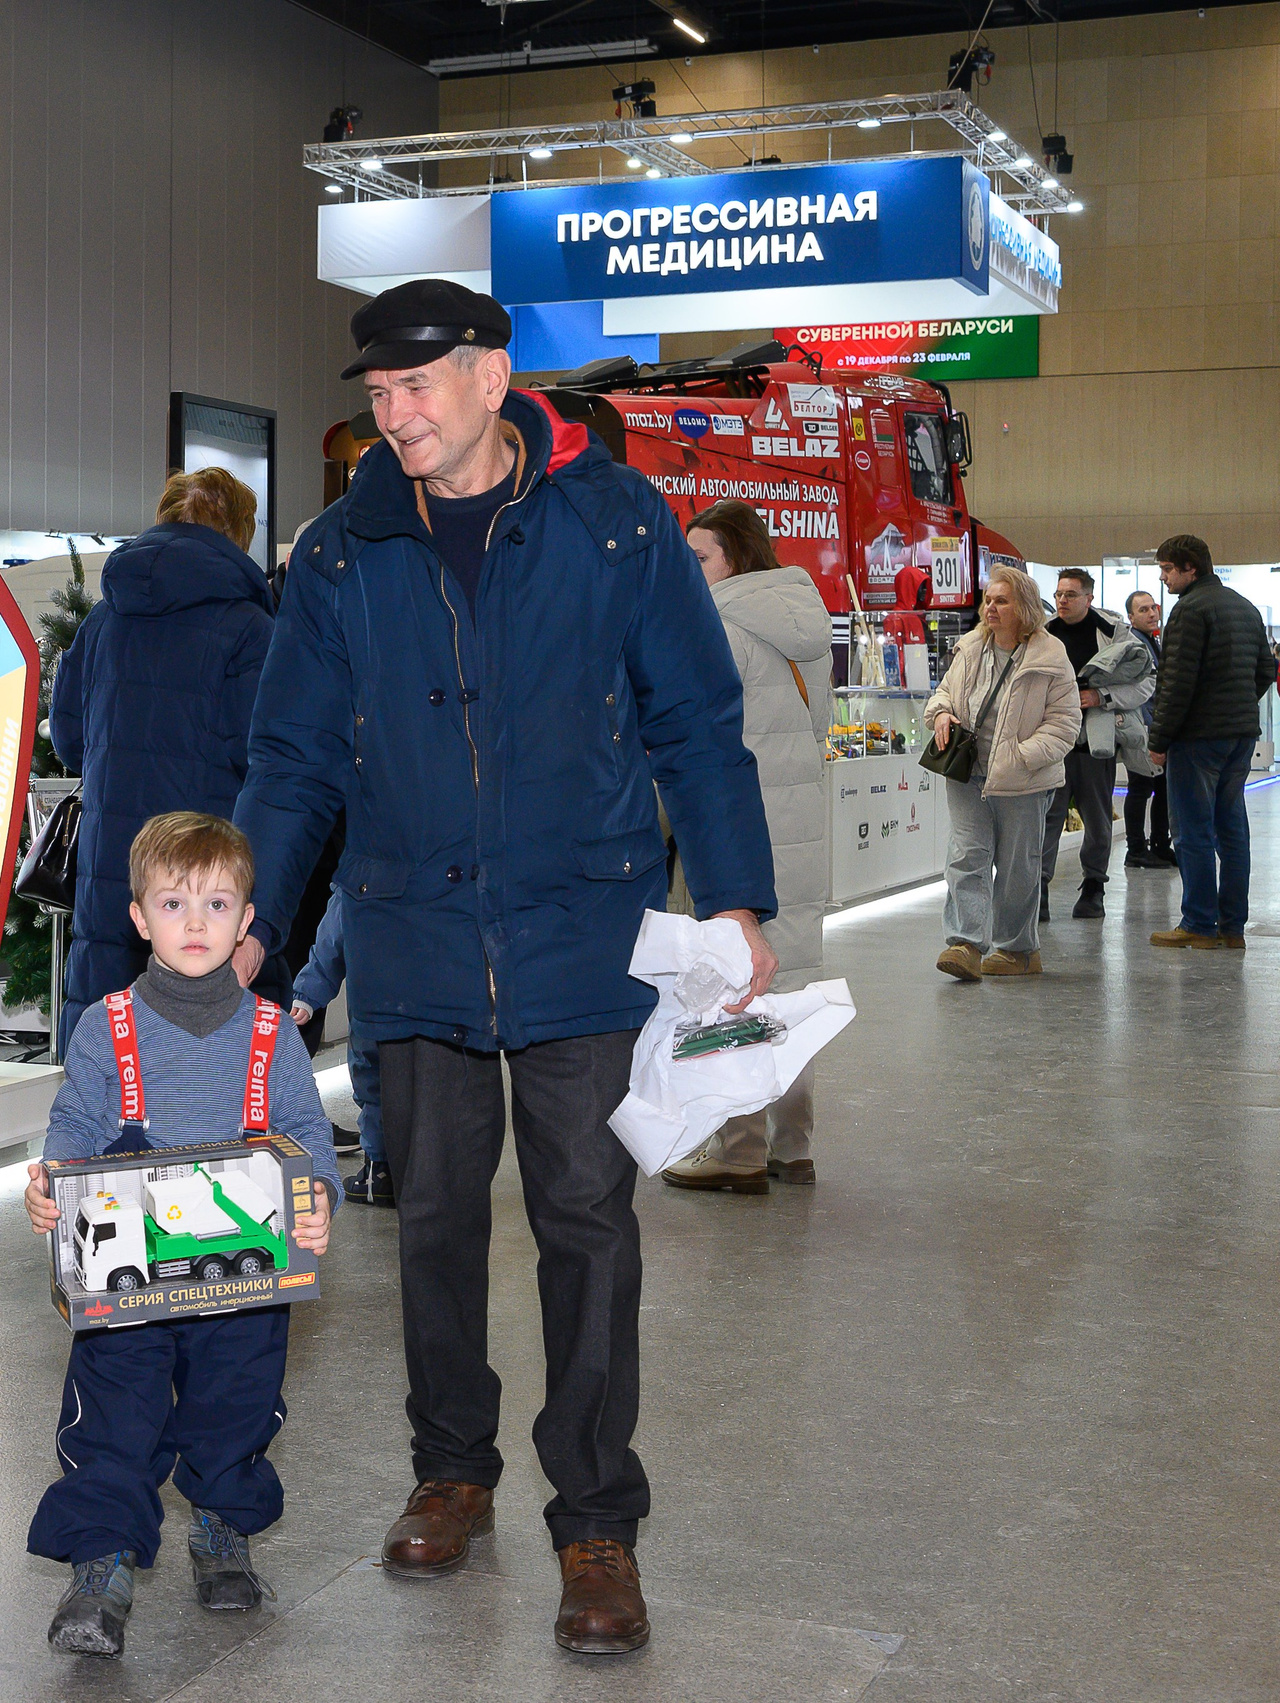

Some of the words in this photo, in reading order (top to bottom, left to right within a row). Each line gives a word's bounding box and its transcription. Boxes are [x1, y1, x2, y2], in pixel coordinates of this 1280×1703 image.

[556, 190, 878, 243] ПРОГРЕССИВНАЯ
[606, 231, 824, 276] МЕДИЦИНА
[796, 321, 913, 343] СУВЕРЕННОЙ
[918, 318, 1014, 338] БЕЛАРУСИ
[845, 356, 856, 366] 19
[857, 355, 898, 366] ДЕКАБРЯ
[899, 354, 911, 363] по
[913, 352, 926, 363] 23
[927, 351, 971, 362] ФЕВРАЛЯ
[625, 411, 672, 432] maz.by
[679, 417, 707, 427] BELOMO
[752, 436, 840, 458] BELAZ
[647, 475, 696, 496] ИНСКИЙ
[699, 479, 800, 501] АВТОМОБИЛЬНЫЙ
[802, 485, 839, 506] ЗАВОД
[755, 508, 839, 540] ELSHINA
[935, 557, 958, 588] 301
[250, 1050, 268, 1122] reima
[119, 1292, 164, 1309] СЕРИЯ
[169, 1278, 273, 1302] СПЕЦТЕХНИКИ
[170, 1301, 217, 1313] автомобиль
[220, 1292, 273, 1307] инерционный
